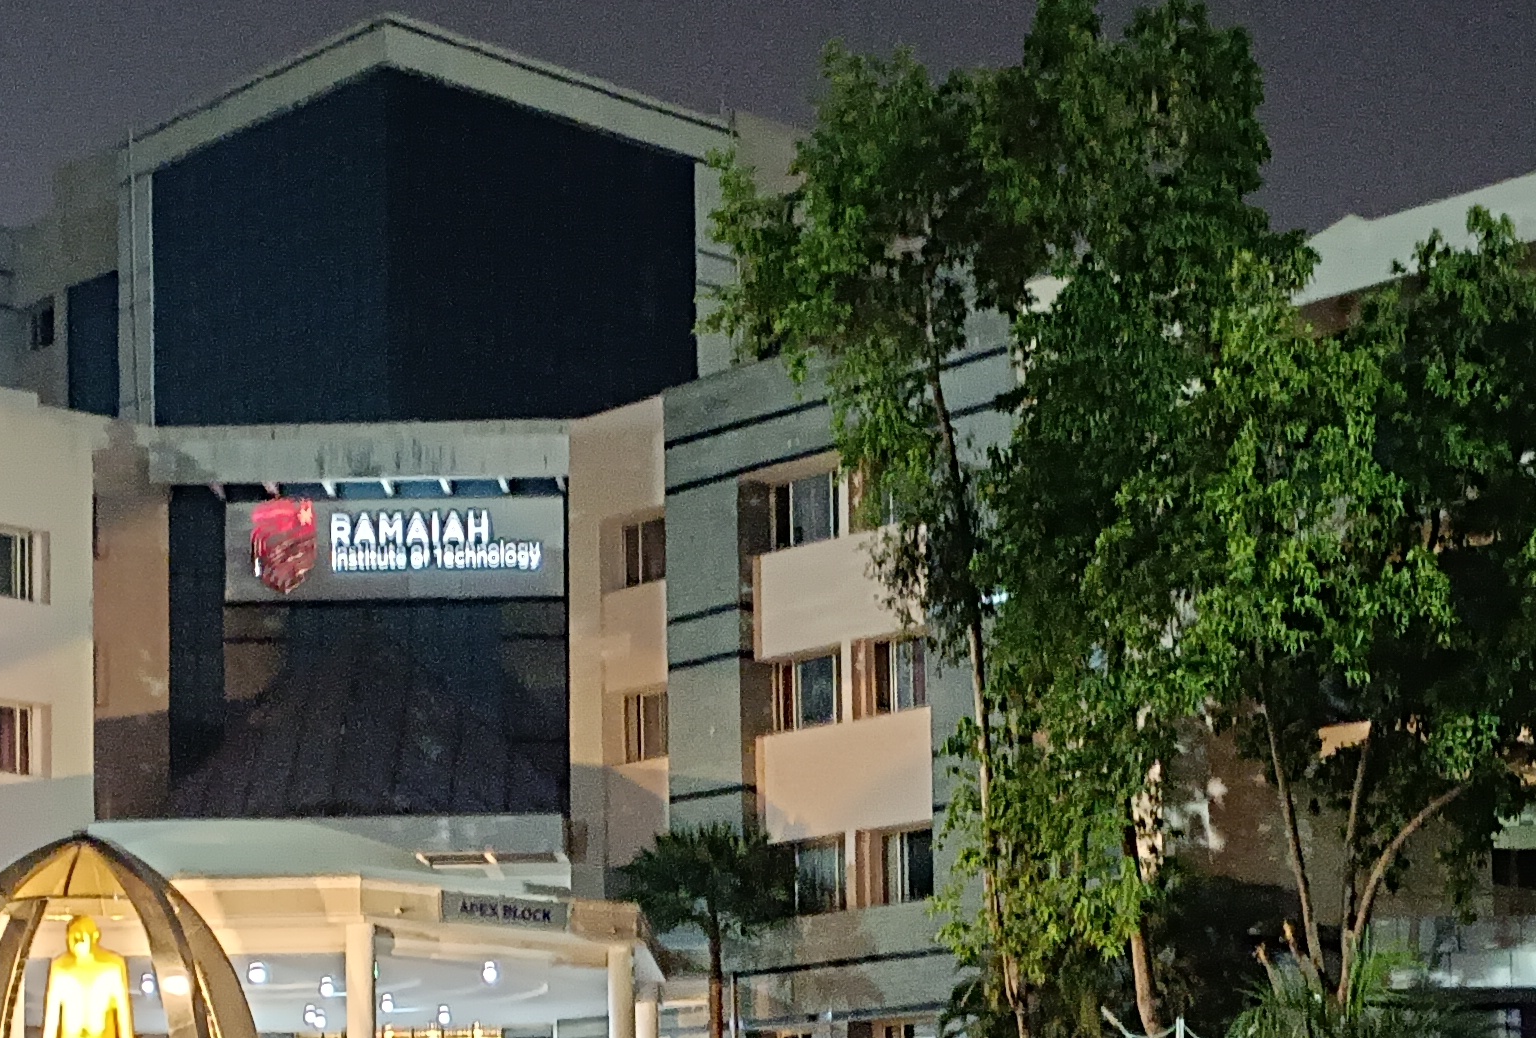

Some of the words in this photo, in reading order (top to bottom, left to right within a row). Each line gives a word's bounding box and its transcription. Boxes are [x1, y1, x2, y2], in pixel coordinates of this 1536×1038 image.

[330, 510, 490, 548] RAMAIAH
[331, 541, 407, 572] Institute
[410, 541, 430, 570] of
[433, 538, 542, 570] Technology
[502, 903, 551, 923] BLOCK
